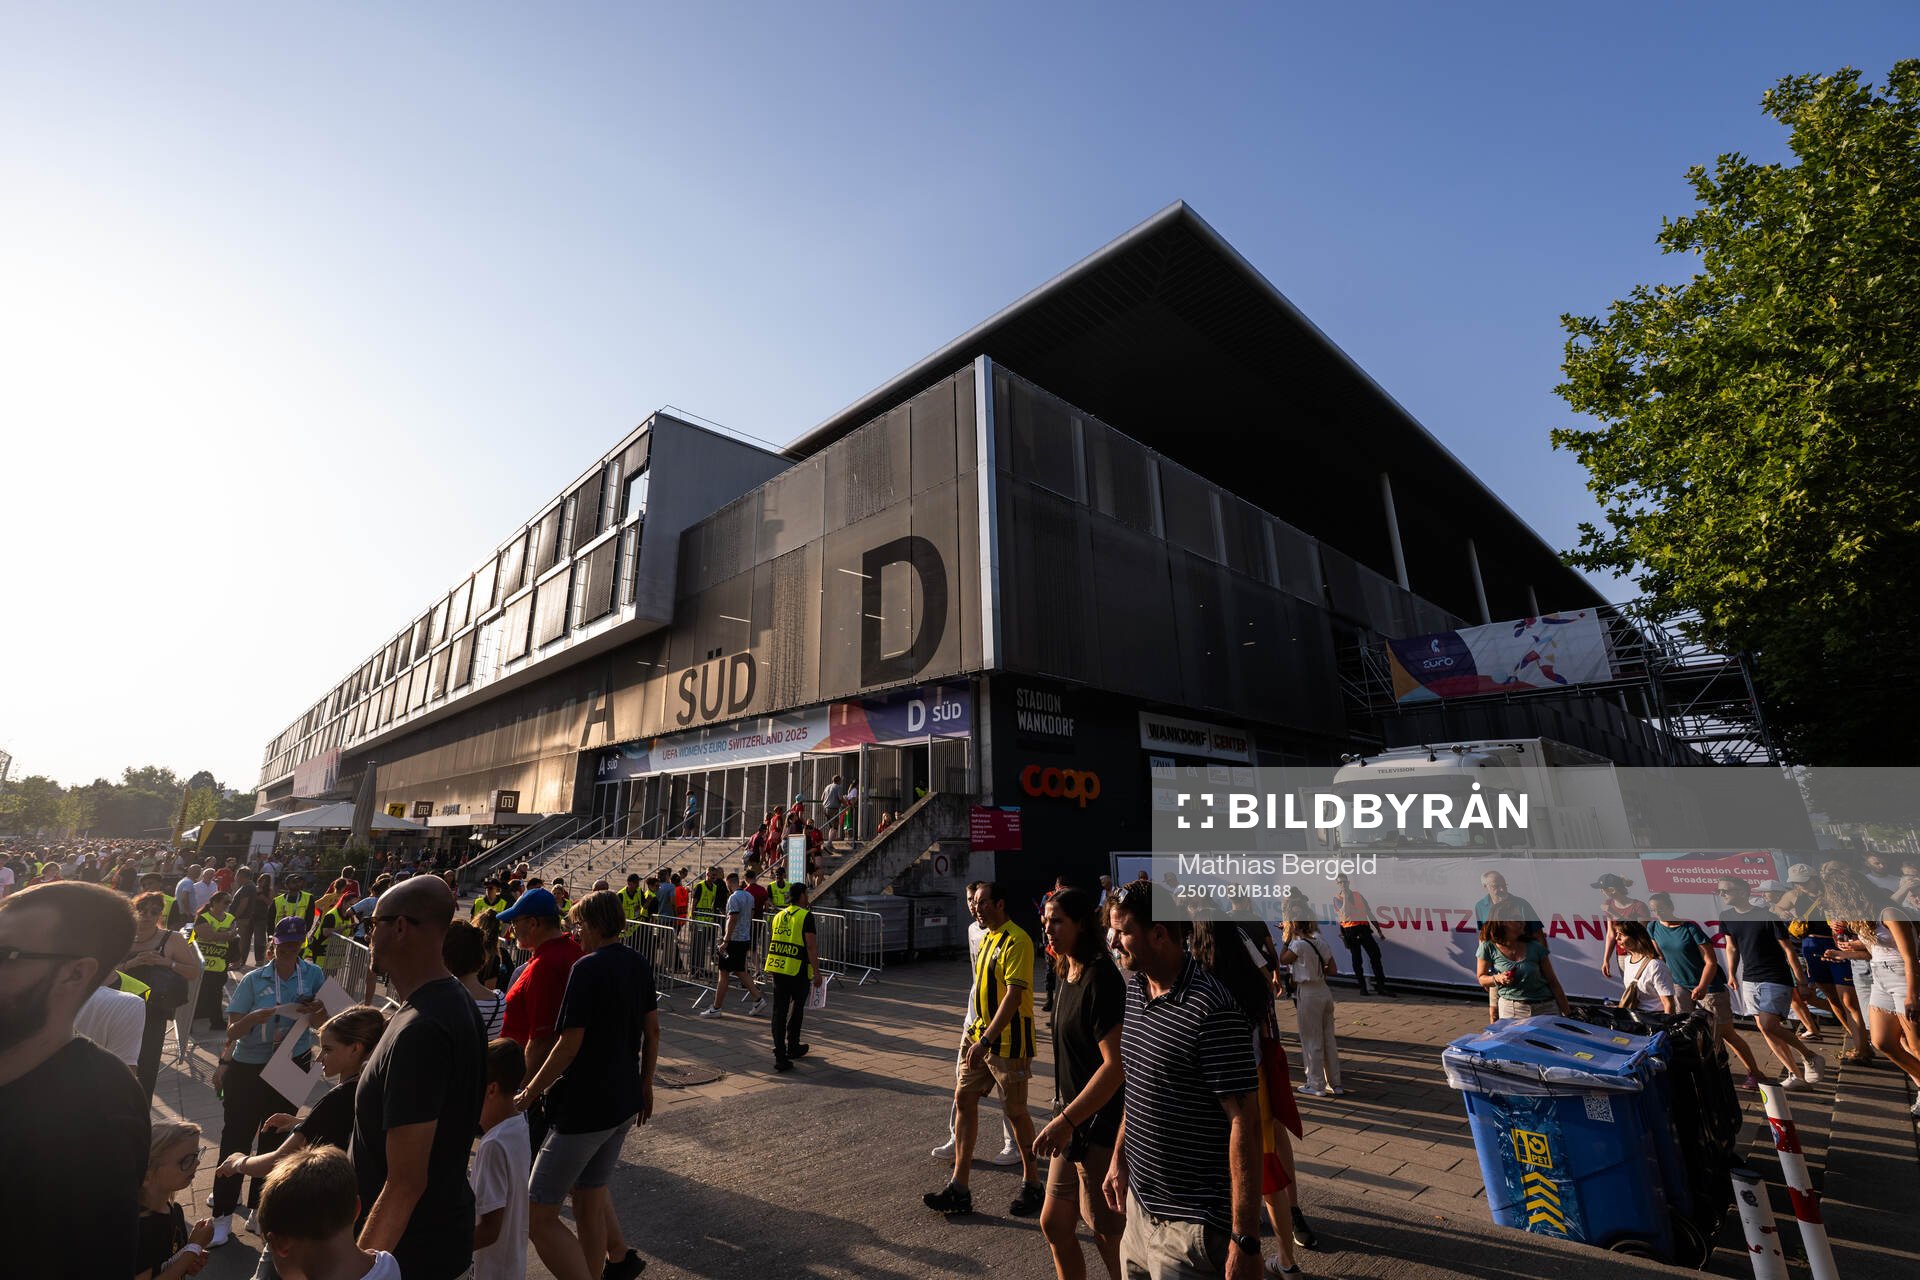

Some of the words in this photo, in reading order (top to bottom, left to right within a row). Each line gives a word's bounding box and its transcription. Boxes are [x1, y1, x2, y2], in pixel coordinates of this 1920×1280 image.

[676, 648, 757, 726] SÜD
[861, 535, 948, 688] D
[1016, 687, 1061, 713] STADION
[907, 699, 926, 732] D
[932, 701, 962, 722] SÜD
[1017, 710, 1075, 737] WANKDORF
[662, 746, 678, 761] UEFA
[708, 740, 727, 753] EURO
[727, 730, 783, 751] SWITZERLAND
[785, 727, 808, 743] 2025
[1148, 722, 1207, 746] WANKDORF
[1213, 733, 1248, 753] CENTER
[598, 756, 606, 775] A
[1377, 766, 1415, 774] TELEVISION
[1021, 763, 1101, 808] coop
[390, 805, 405, 817] 71
[1665, 865, 1732, 875] Accreditation
[1733, 866, 1769, 875] Centre
[1672, 876, 1722, 885] Broadcas
[767, 958, 786, 969] 252
[1531, 1154, 1549, 1165] PET
